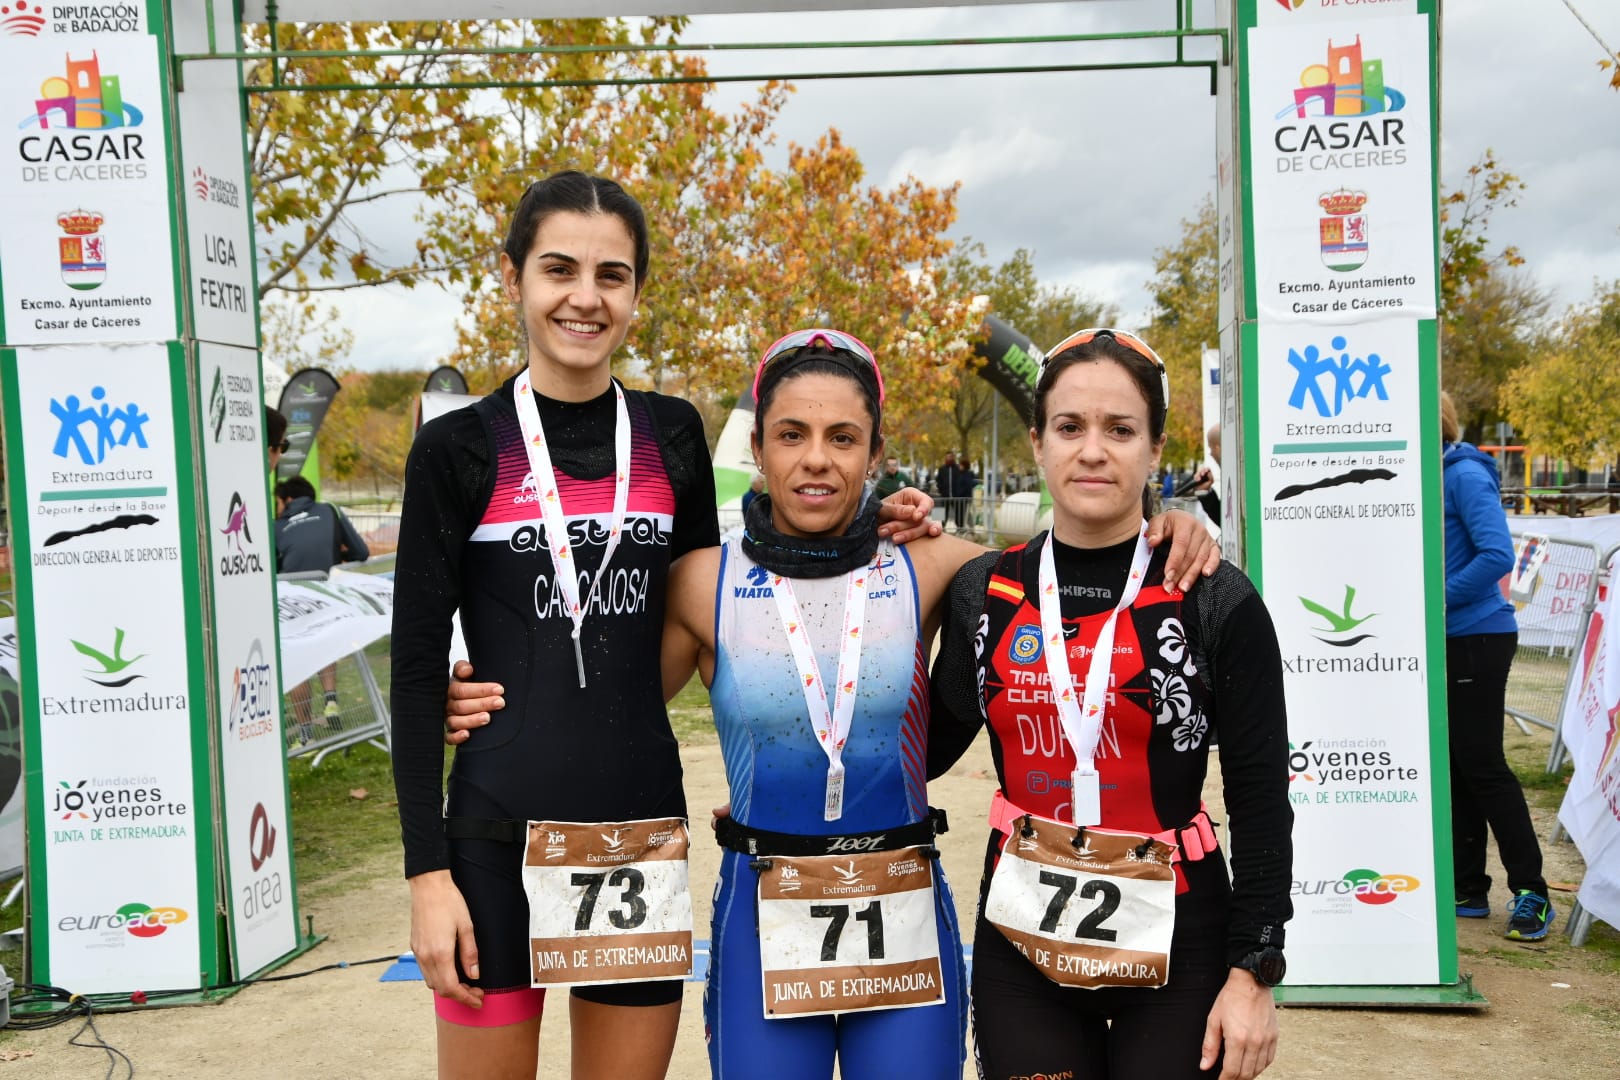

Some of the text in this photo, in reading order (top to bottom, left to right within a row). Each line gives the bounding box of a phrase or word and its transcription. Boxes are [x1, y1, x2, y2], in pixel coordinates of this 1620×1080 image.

[53, 2, 138, 20] DIPUTACIÓN
[54, 18, 139, 33] DE BADAJOZ
[1275, 118, 1405, 152] CASAR
[19, 134, 145, 162] CASAR
[1277, 149, 1407, 173] DE CÁCERES
[22, 166, 49, 182] DE
[205, 233, 237, 268] LIGA
[1279, 275, 1416, 294] Excmo. Ayuntamiento
[21, 295, 152, 310] Excmo. Ayuntamiento
[200, 278, 247, 312] FEXTRI
[1293, 297, 1403, 314] Casar de Cáceres
[35, 316, 141, 330] Casar de Cáceres
[1287, 421, 1392, 436] Extremadura
[1270, 454, 1405, 470] Deporte desde la Base
[52, 467, 152, 484] Extremadura
[38, 501, 166, 517] Deporte desde la Base
[1264, 503, 1415, 521] DIRECCION GENERAL DE DEPORTES
[34, 547, 178, 566] DIRECCION GENERAL DE DEPORTES
[221, 553, 263, 576] austral
[734, 587, 775, 598] VIATO
[868, 588, 897, 600] CAPEX
[1021, 628, 1041, 636] GRUPO
[1282, 651, 1419, 674] xtremadura
[43, 692, 186, 716] Extremadura
[1318, 738, 1386, 749] fundación
[92, 776, 157, 788] fundación
[1318, 766, 1418, 785] ydeporte
[1316, 792, 1329, 803] DE
[1335, 790, 1418, 803] EXTREMADURA
[93, 801, 187, 823] ydeporte
[54, 826, 187, 845] JUNTA DE EXTREMADURA
[587, 853, 635, 863] Extremadura
[1055, 855, 1110, 870] Extremadura
[243, 872, 282, 920] area
[823, 884, 877, 895] Extremadura
[1289, 877, 1408, 896] euroace
[571, 867, 647, 931] 73
[1039, 870, 1122, 943] 72
[58, 910, 177, 931] euroace
[810, 900, 885, 961] 71
[537, 944, 688, 973] JUNTA DE EXTREMADURA
[1035, 948, 1051, 968] DE
[1056, 954, 1158, 980] EXTREMADURA
[773, 971, 936, 1004] JUNTA DE EXTREMADURA
